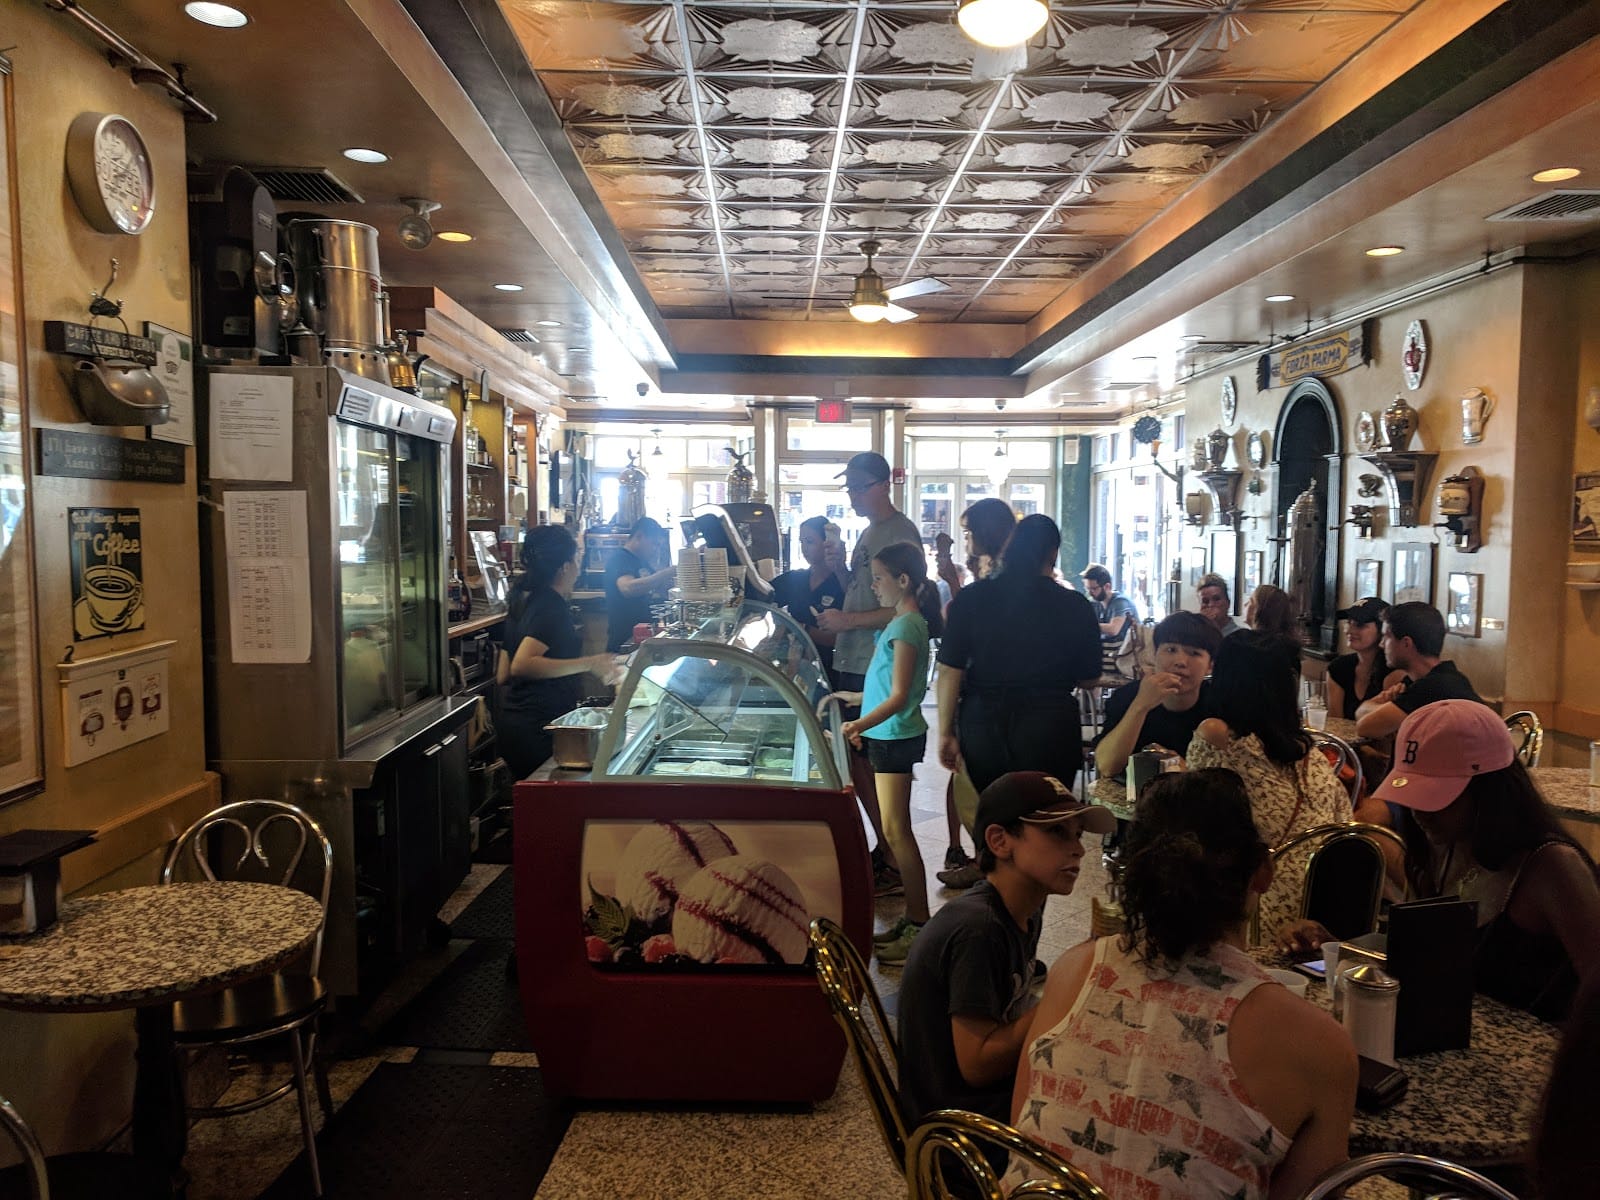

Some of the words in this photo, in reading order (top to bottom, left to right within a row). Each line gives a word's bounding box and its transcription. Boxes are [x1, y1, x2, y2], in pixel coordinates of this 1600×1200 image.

[1286, 354, 1310, 373] FORZA
[1311, 346, 1341, 367] PARMA
[93, 532, 140, 565] Coffee
[1402, 740, 1418, 764] B
